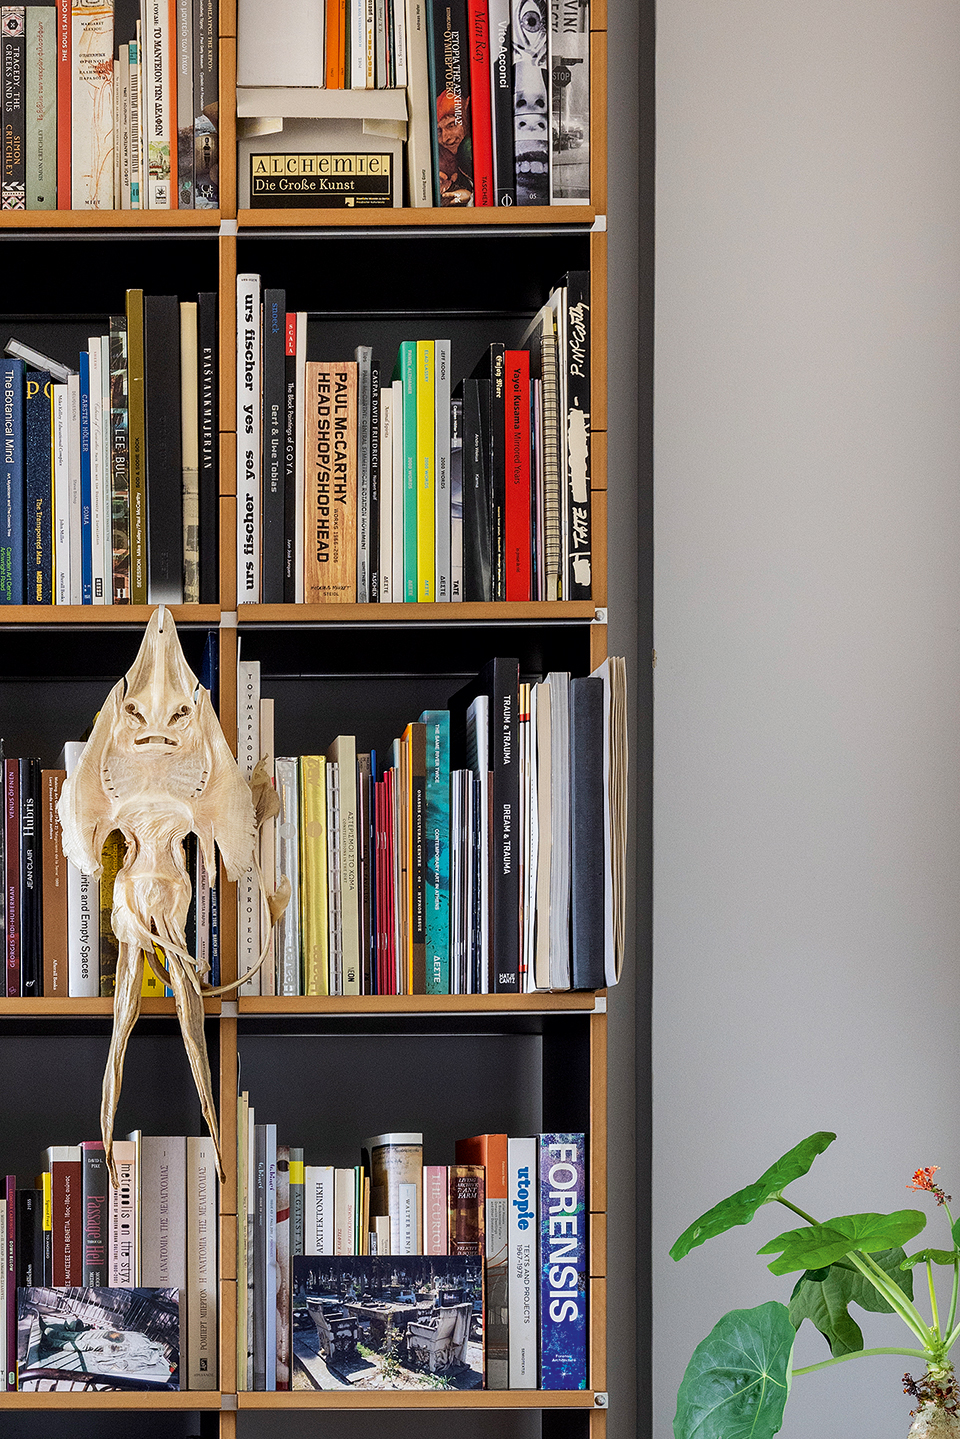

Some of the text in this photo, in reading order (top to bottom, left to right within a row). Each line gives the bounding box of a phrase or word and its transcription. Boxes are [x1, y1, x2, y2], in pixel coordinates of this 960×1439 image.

[475, 11, 486, 64] Man Ray
[499, 20, 507, 88] Vito Acconci
[553, 72, 570, 80] STOP
[6, 102, 12, 112] US
[256, 179, 354, 191] Die Große Kunst
[242, 294, 256, 435] urs fischer yes
[4, 370, 14, 464] The Botanical Mind
[317, 372, 330, 416] HEAD
[115, 429, 125, 477] LEE BUL
[335, 372, 348, 505] PAUL McCARTHY
[242, 450, 256, 590] urs fischer yes
[317, 520, 330, 563] HEAD
[503, 694, 511, 722] TRAUM
[503, 733, 511, 766] TRAUMA
[22, 798, 34, 837] Hubris
[512, 1166, 535, 1231] utopie
[548, 1142, 579, 1323] FORENSIS
[523, 1244, 531, 1324] TEXTS AND PROJECTS
